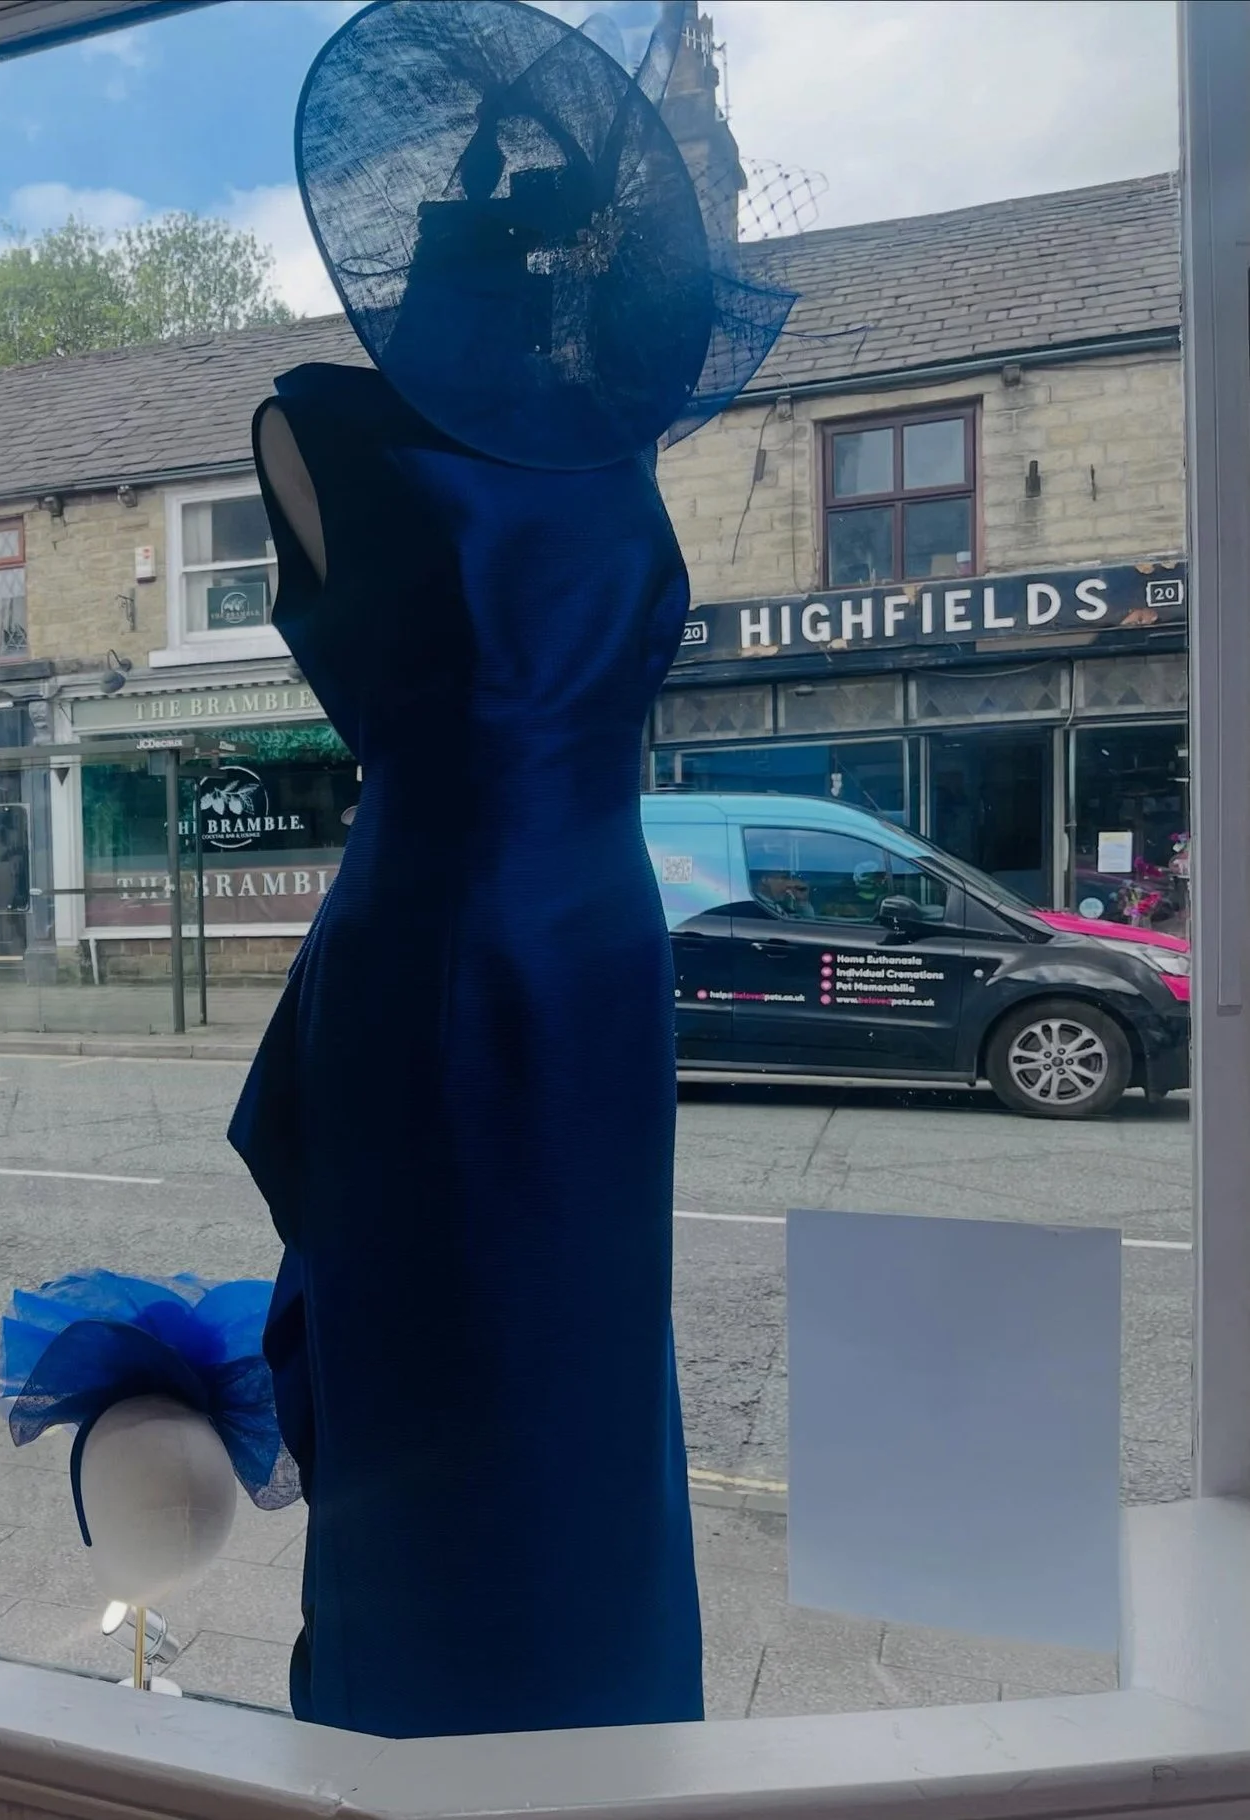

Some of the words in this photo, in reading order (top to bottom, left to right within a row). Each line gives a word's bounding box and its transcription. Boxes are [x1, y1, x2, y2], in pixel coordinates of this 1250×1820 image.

[1154, 587, 1175, 600] 20
[738, 578, 1109, 648] HIGHFIELDS
[684, 627, 701, 640] 20
[134, 699, 182, 721] THE
[193, 870, 330, 898] BRAMBL
[836, 954, 865, 964] Home
[866, 955, 923, 966] Euthanasia
[836, 967, 885, 979] Individual
[886, 969, 945, 980] Cremations
[835, 981, 852, 991] Pet
[853, 982, 916, 993] Memorabilia
